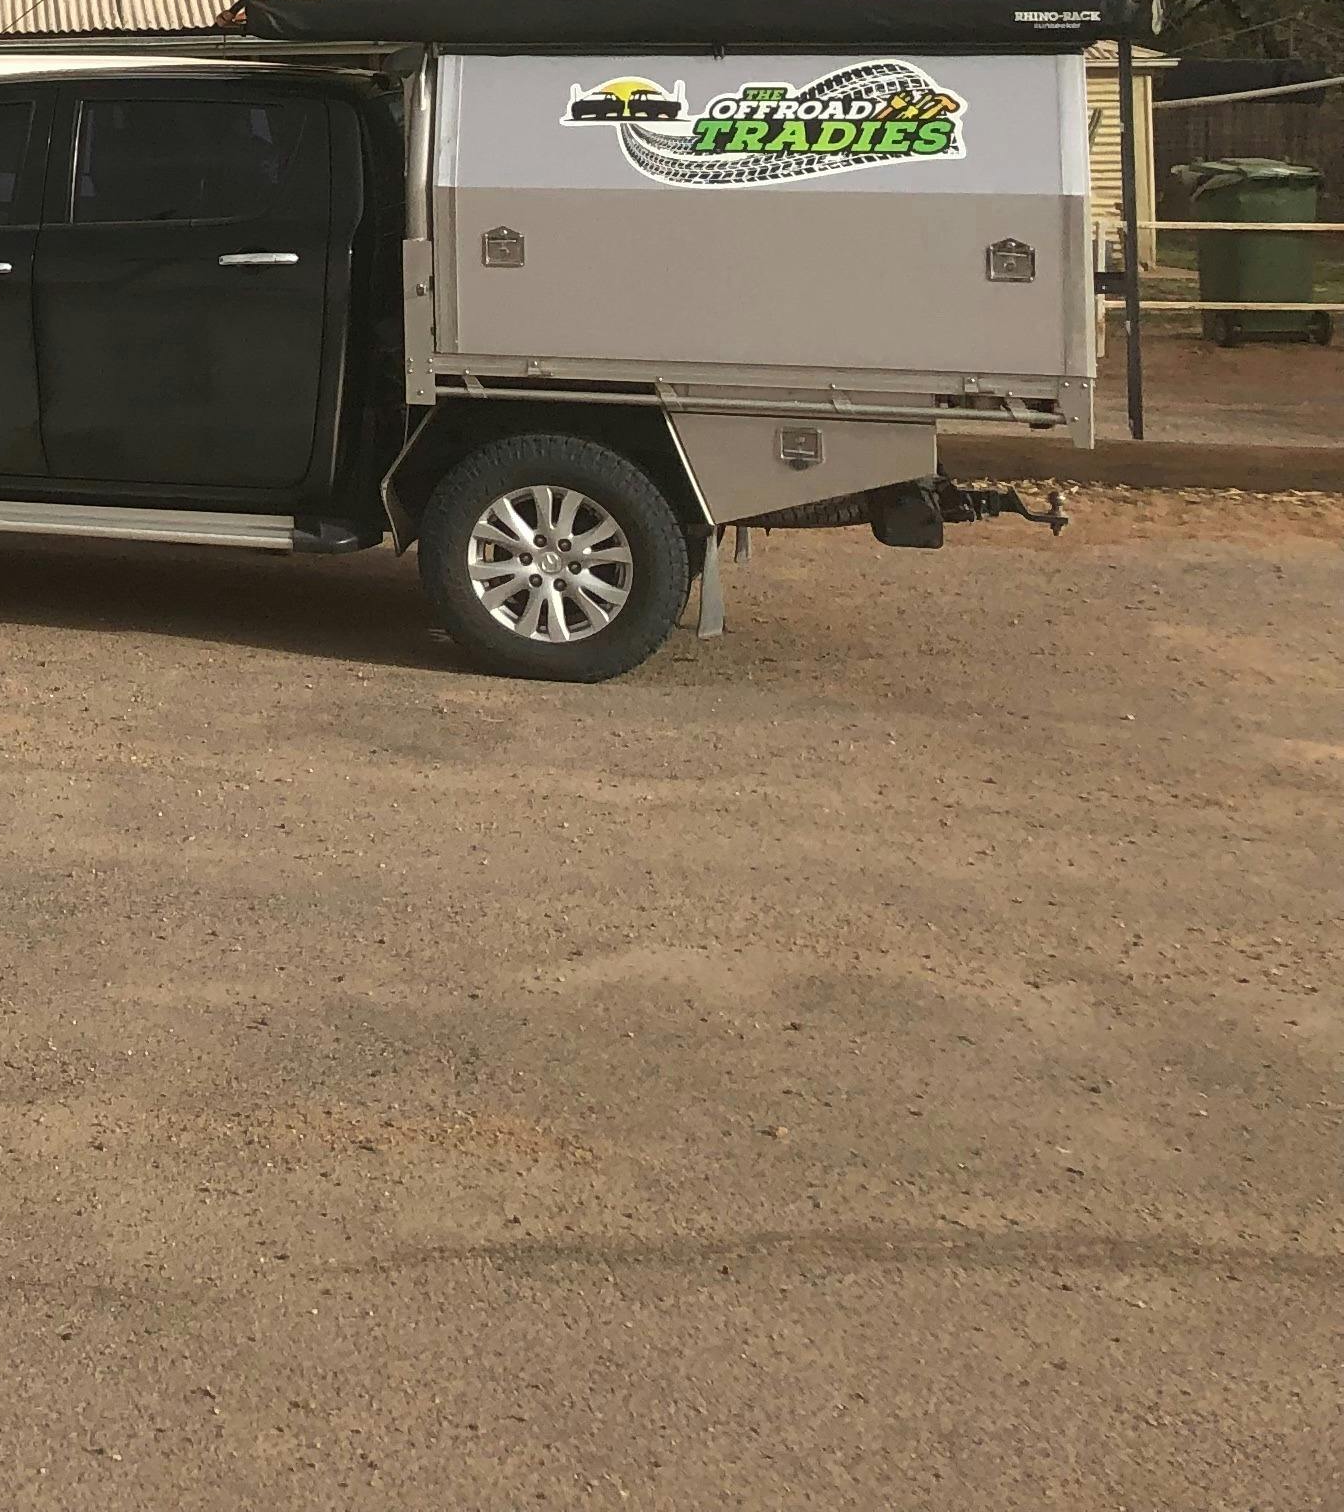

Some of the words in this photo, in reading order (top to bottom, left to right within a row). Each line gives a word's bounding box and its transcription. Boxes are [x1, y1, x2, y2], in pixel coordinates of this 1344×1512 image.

[1014, 11, 1101, 22] RHINO-RACK
[745, 89, 784, 100] THE
[712, 100, 871, 119] OFFROAD
[695, 119, 952, 152] TRADIES
